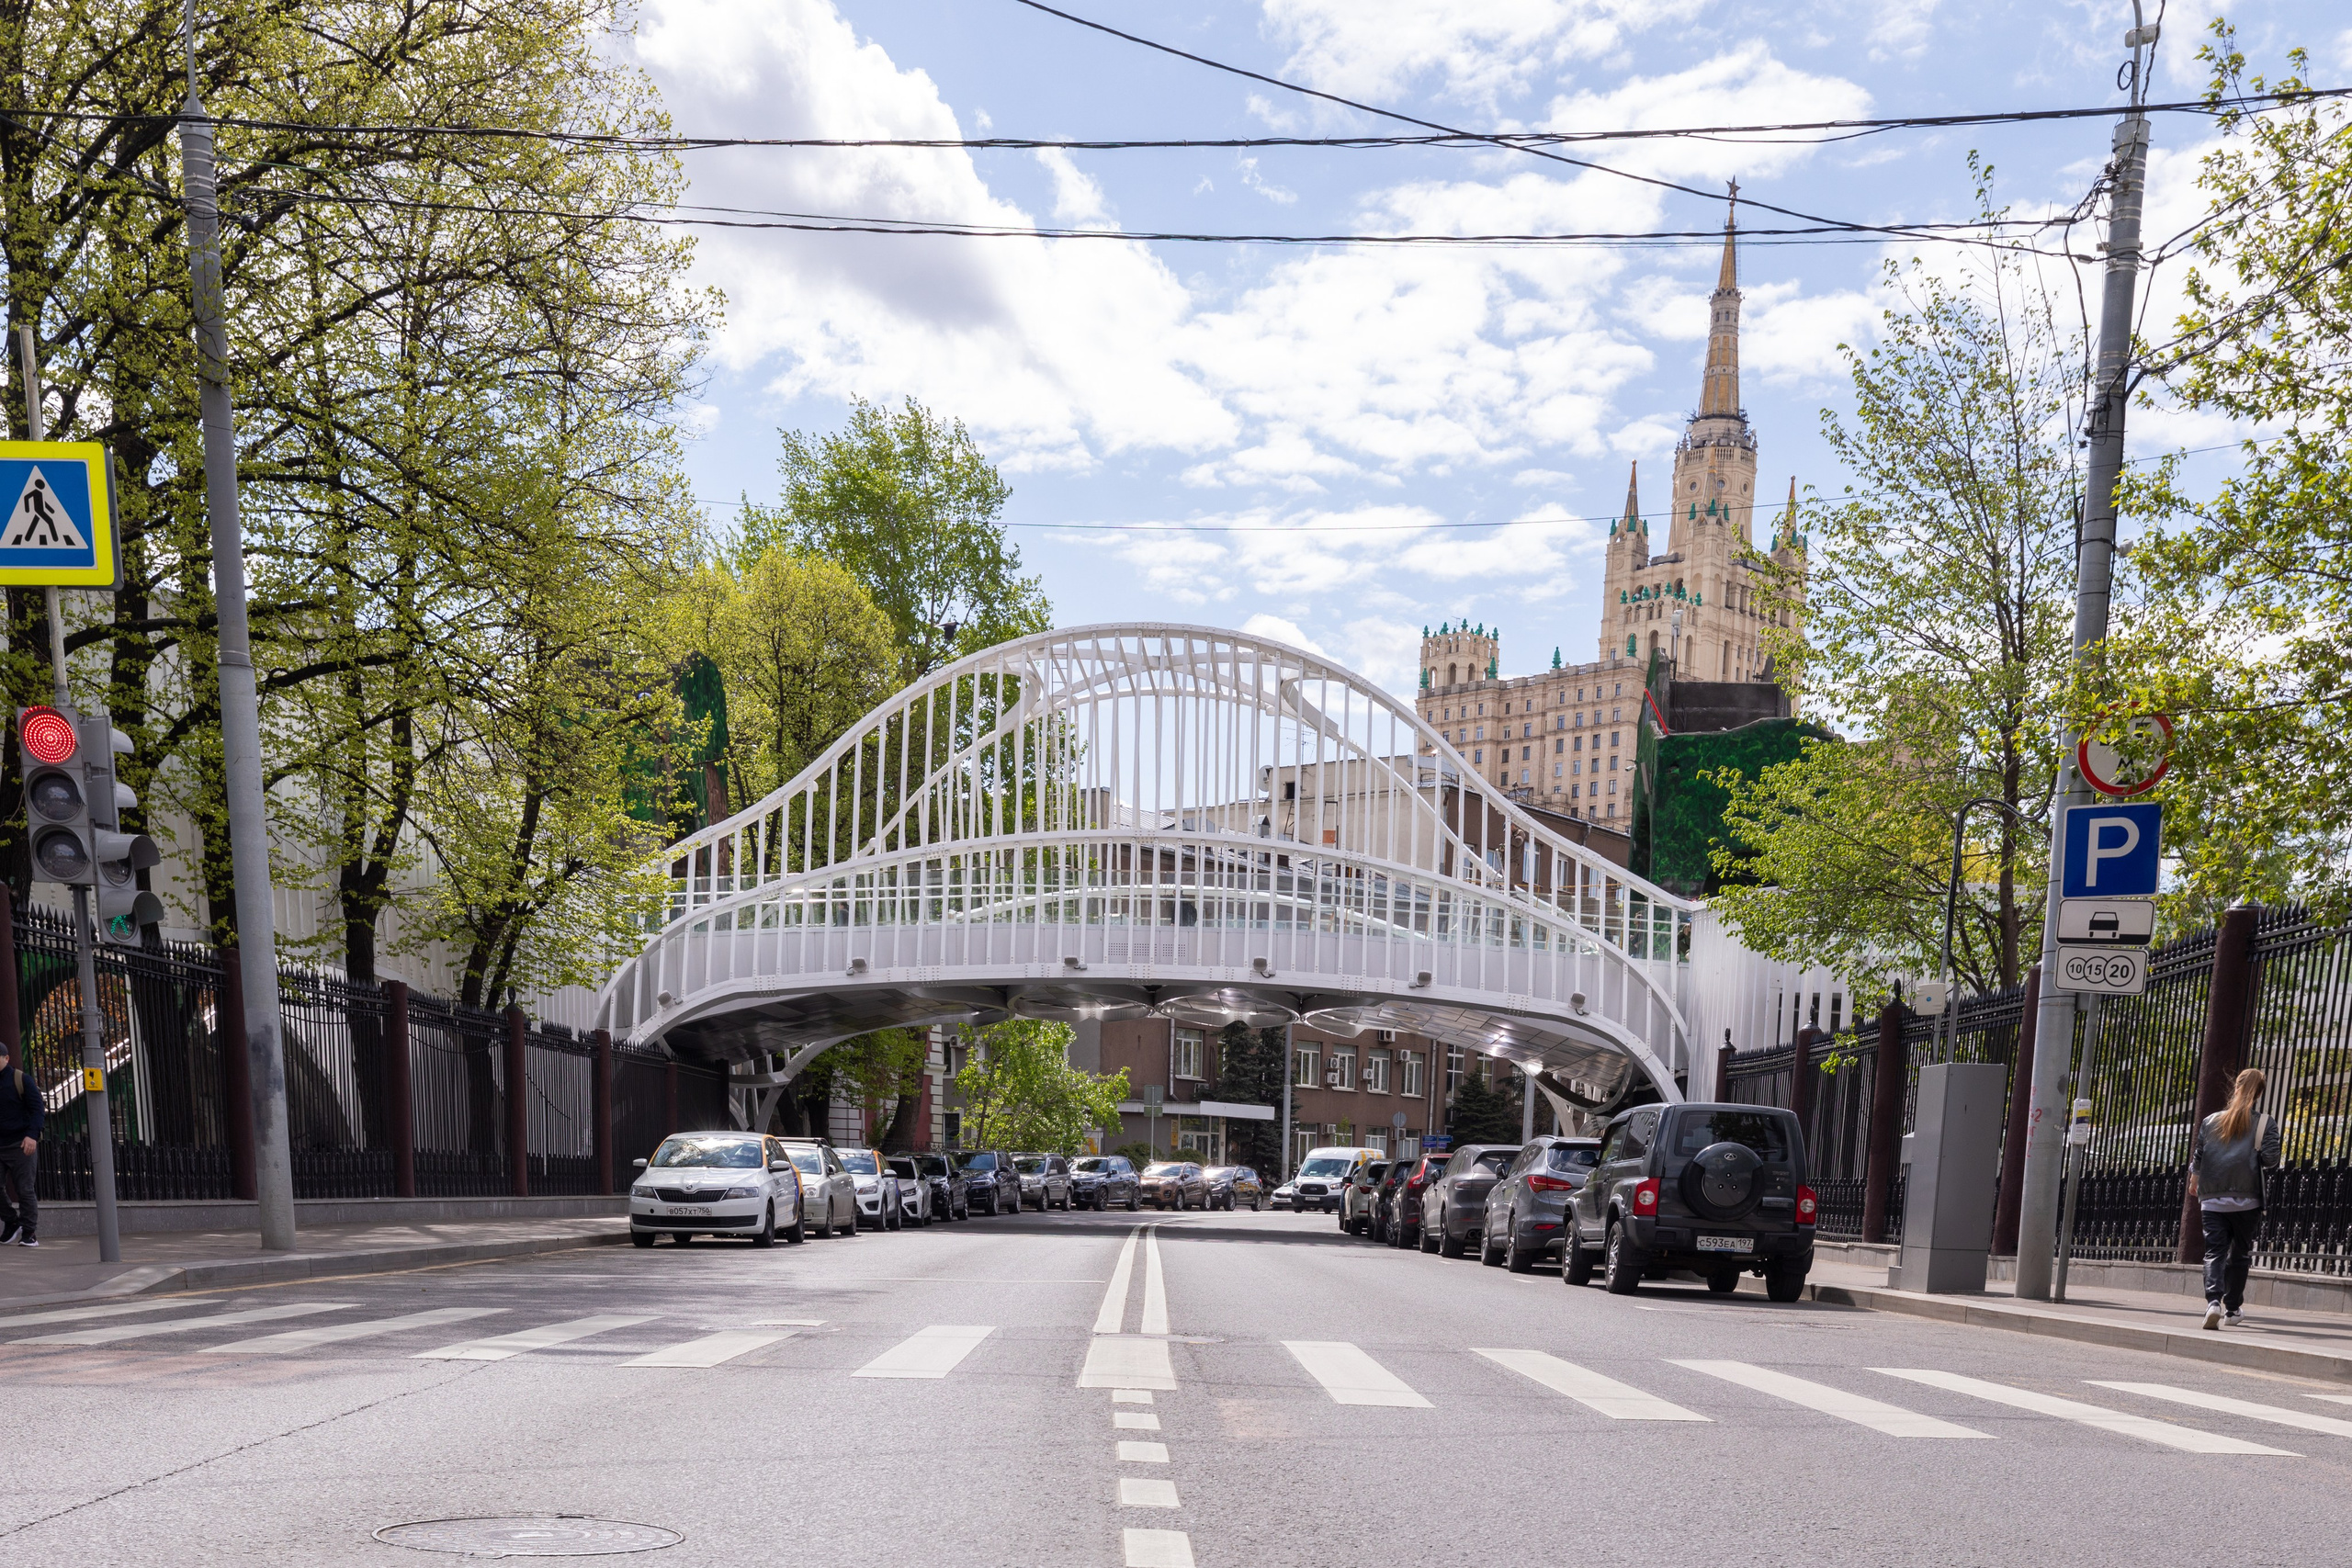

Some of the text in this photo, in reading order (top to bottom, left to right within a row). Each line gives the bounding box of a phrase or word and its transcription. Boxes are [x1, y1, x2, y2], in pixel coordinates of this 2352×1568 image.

[2086, 817, 2140, 887] P
[2069, 964, 2130, 978] 10 15 20
[1737, 1238, 1751, 1247] 197
